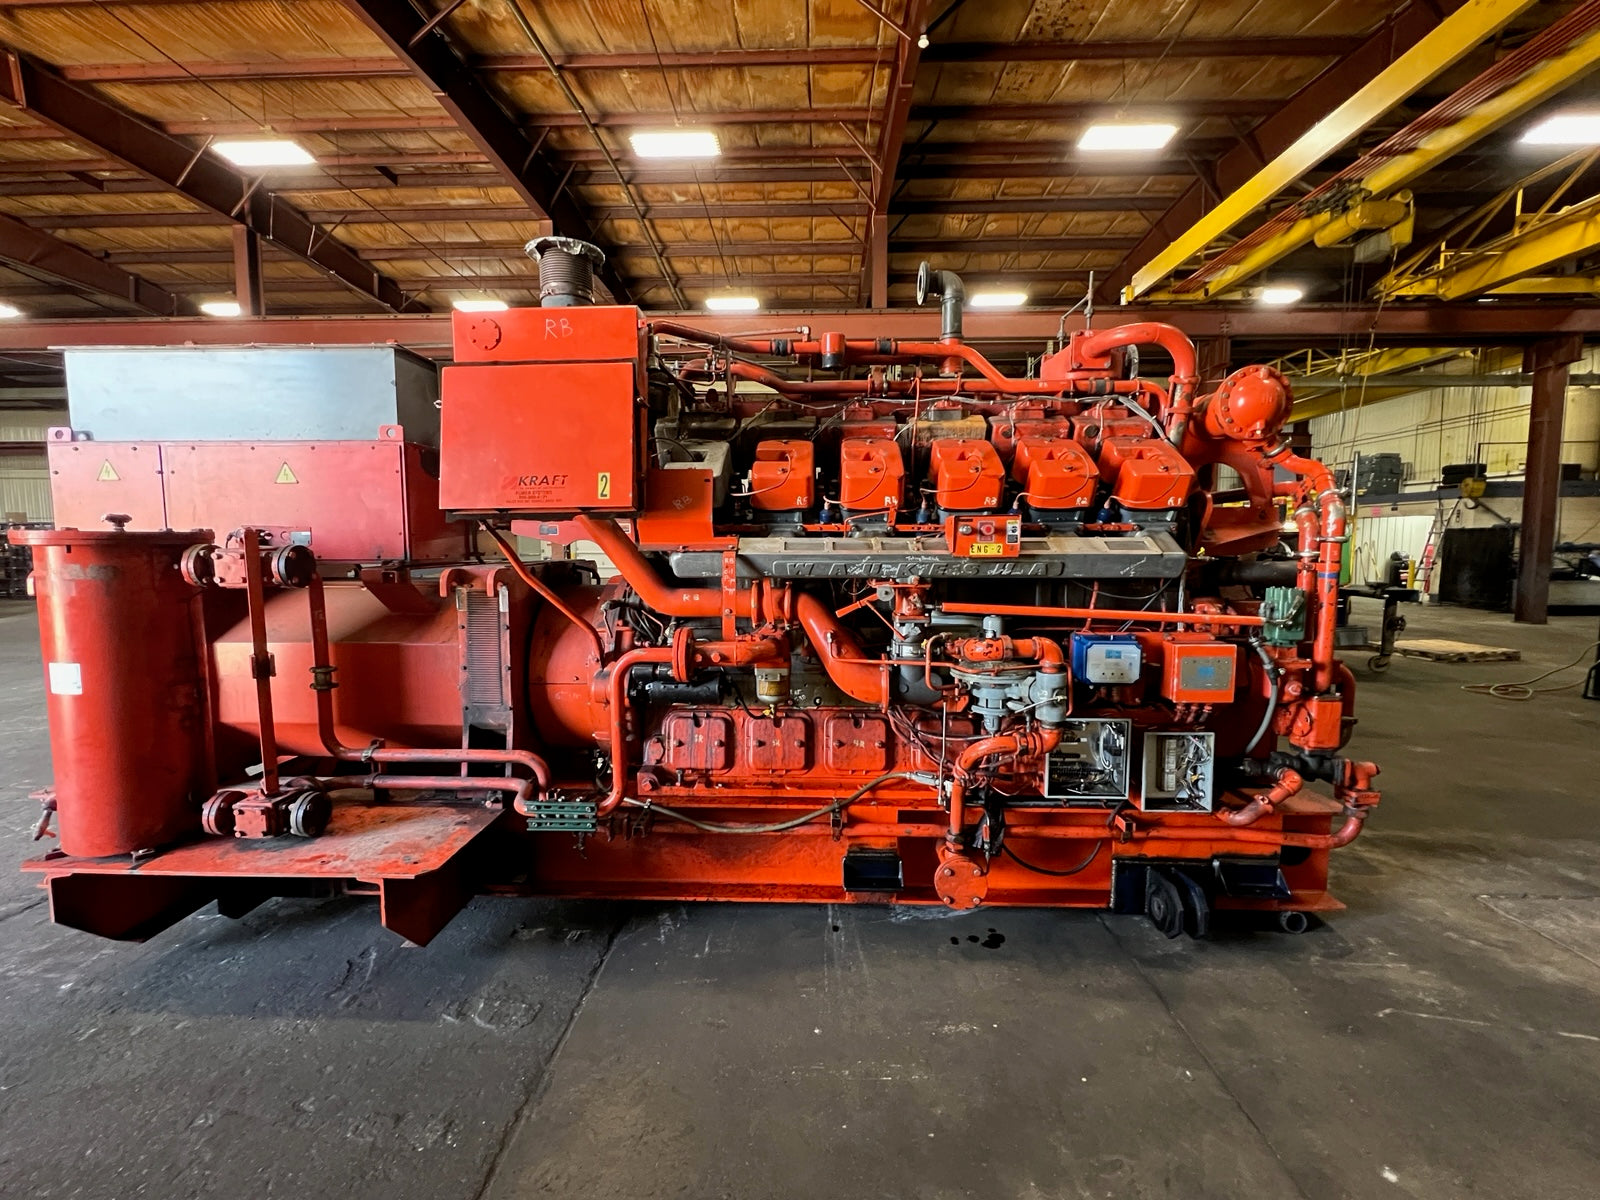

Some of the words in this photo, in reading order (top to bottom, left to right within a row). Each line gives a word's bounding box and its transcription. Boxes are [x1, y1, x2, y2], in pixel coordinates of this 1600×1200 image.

[545, 318, 574, 340] RB
[518, 474, 569, 486] KRAFT
[600, 474, 608, 498] 2
[884, 496, 898, 506] R4
[984, 496, 998, 506] R3
